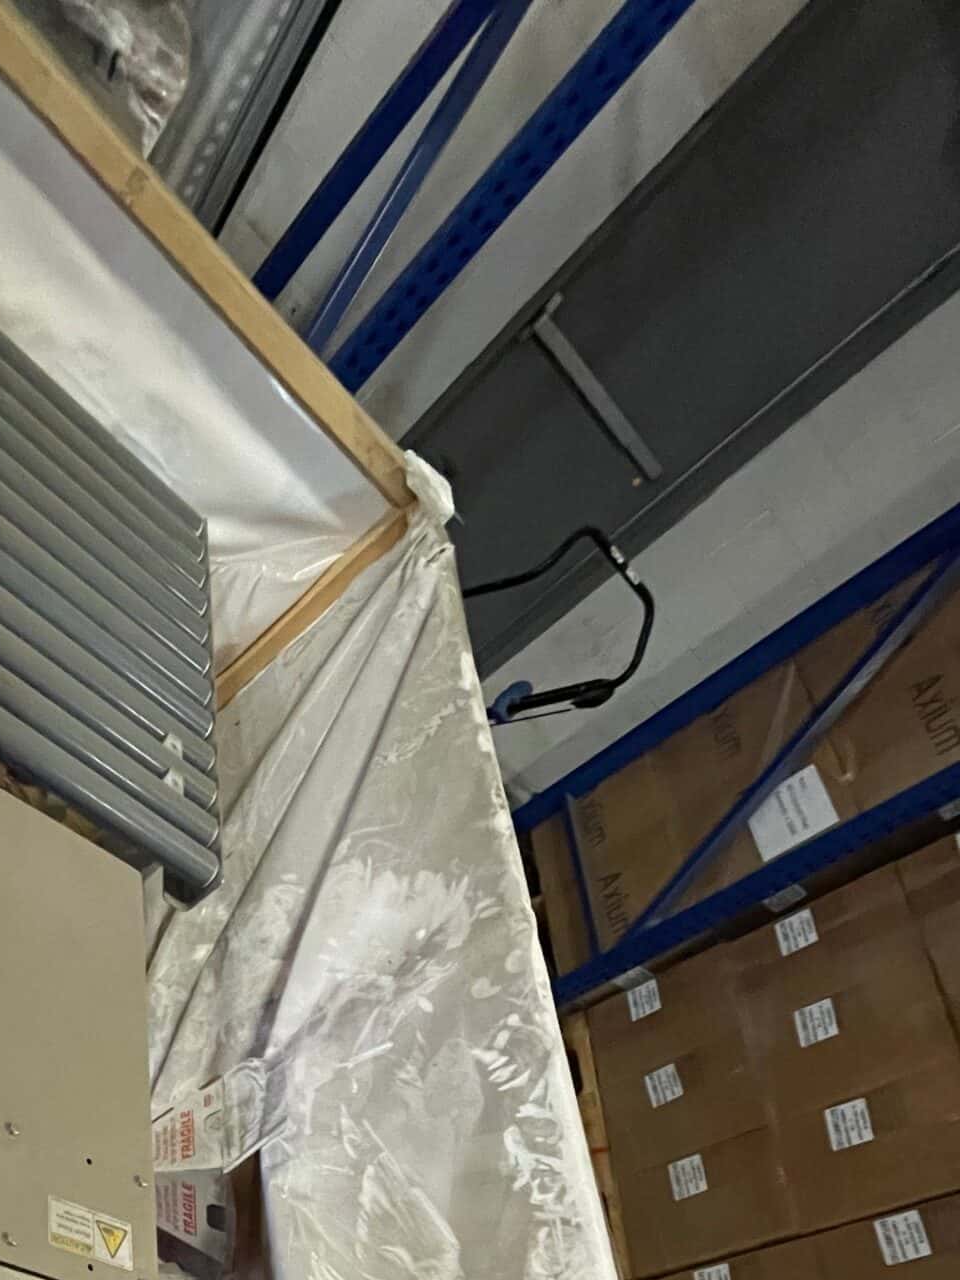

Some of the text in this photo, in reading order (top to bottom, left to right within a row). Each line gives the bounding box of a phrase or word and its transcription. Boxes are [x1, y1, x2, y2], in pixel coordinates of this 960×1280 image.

[907, 672, 960, 756] Axium
[180, 1110, 194, 1161] FRAGILE
[182, 1182, 197, 1235] FRAGILE
